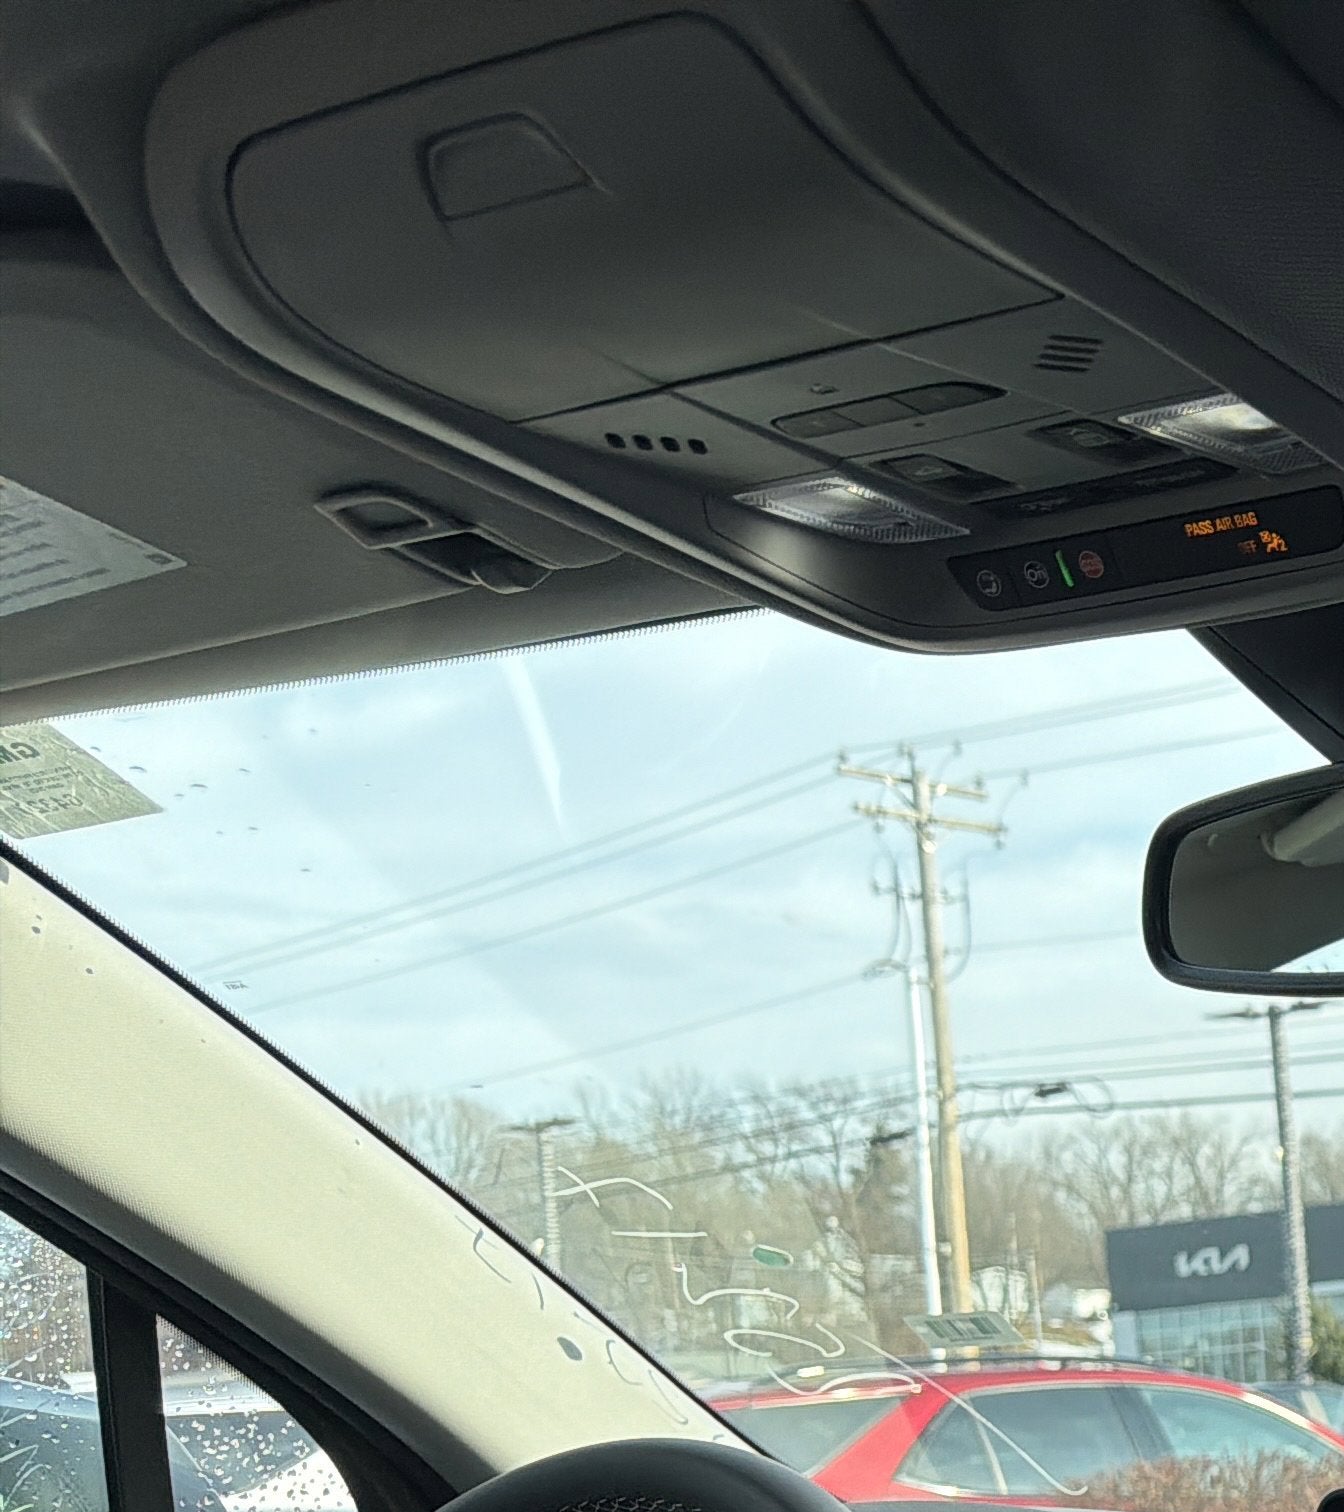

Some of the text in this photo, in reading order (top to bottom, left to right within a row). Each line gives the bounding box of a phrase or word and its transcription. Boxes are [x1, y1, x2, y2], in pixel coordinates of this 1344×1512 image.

[1185, 511, 1258, 537] PASS AIR BAG
